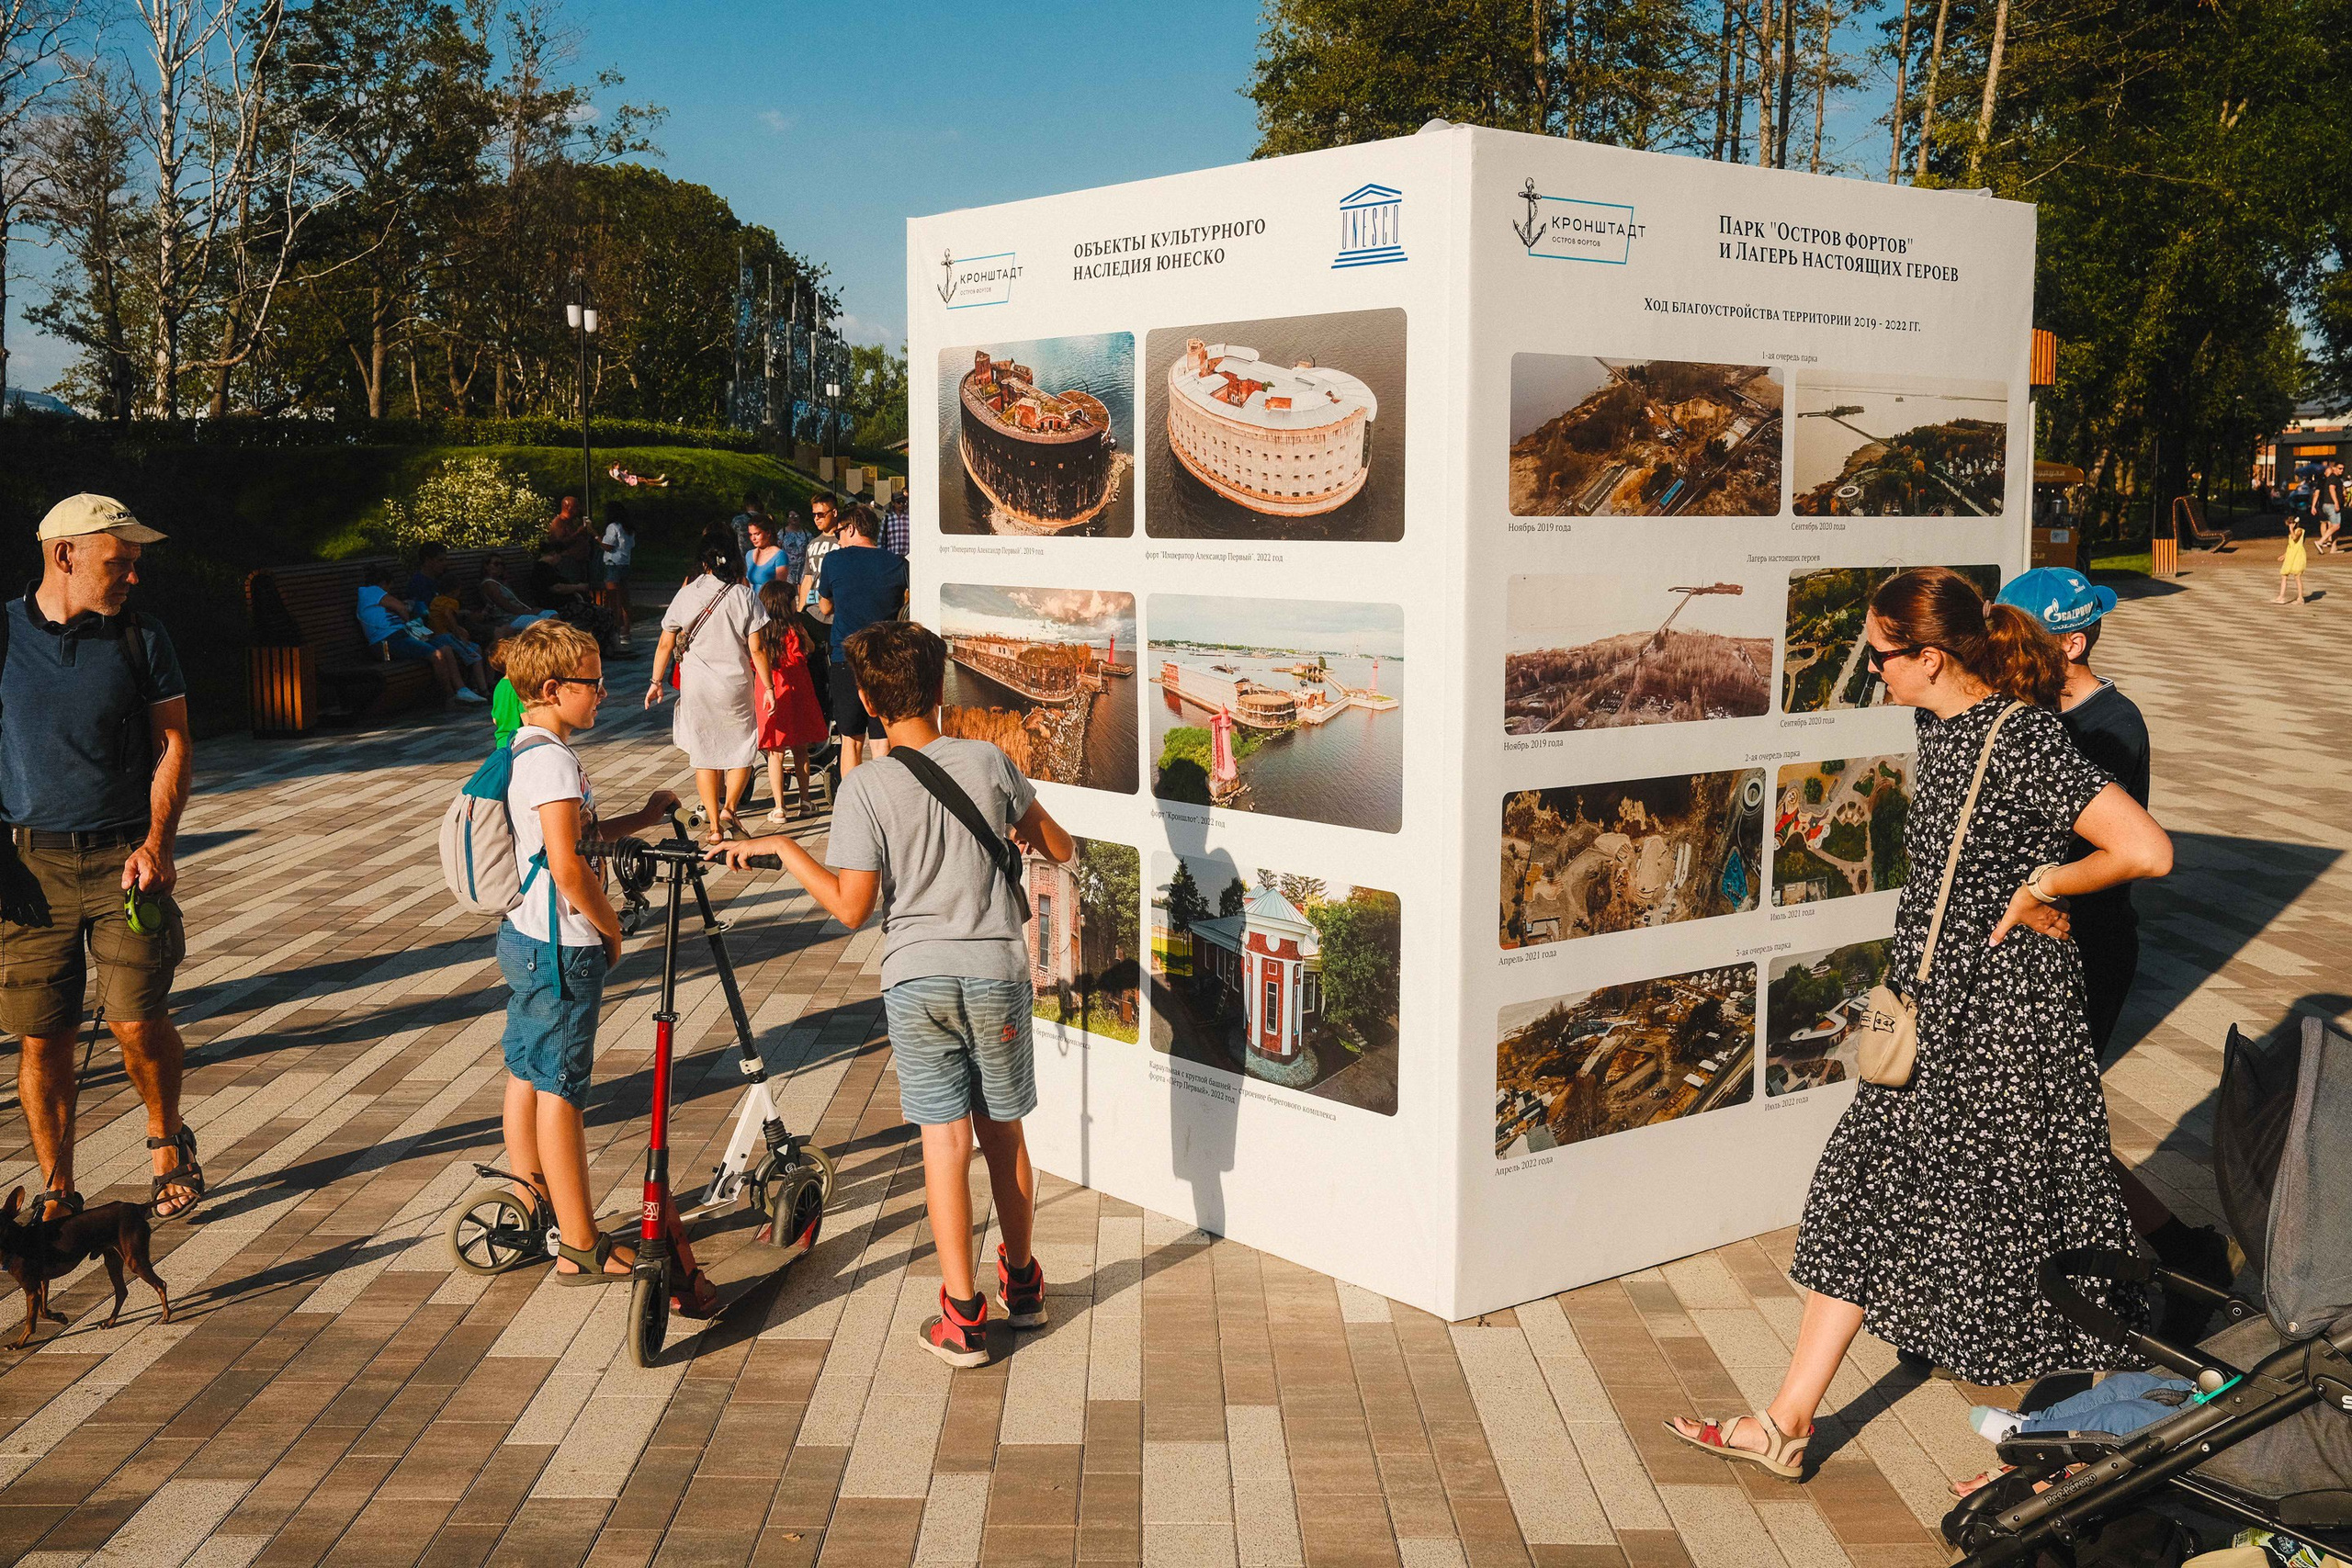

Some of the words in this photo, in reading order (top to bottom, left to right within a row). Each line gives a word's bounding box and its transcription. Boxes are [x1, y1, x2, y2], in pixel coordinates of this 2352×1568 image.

[1342, 204, 1399, 250] UNESCO
[1551, 216, 1646, 240] КРОНШТАДТ
[1074, 234, 1147, 259] ОБЪЕКТЫ
[1150, 218, 1266, 249] КУЛЬТУРНОГО
[1552, 236, 1577, 245] ОСТРОВ
[1577, 239, 1601, 247] ФОРТОВ
[1073, 256, 1152, 281] НАСЛЕДИЯ
[1156, 247, 1226, 271] ЮНЕСКО
[1802, 251, 1902, 277] НАСТОЯЩИХ
[1906, 263, 1960, 283] ГЕРОЕВ
[959, 266, 1023, 285] КРОНШТАДТ
[1672, 301, 1781, 321] БЛАГОУСТРОЙСТВА
[1782, 310, 1852, 327] ТЕРРИТОРИИ
[1854, 316, 1877, 331] 2019
[1885, 320, 1907, 332] 2022
[1761, 351, 1775, 361] 1-ая
[1775, 353, 1801, 363] очередь
[1801, 355, 1818, 364] парка
[1508, 523, 1536, 534] Ноябрь
[1537, 523, 1555, 532] 2019
[1555, 525, 1572, 533] года
[1791, 522, 1819, 533] Сентябрь
[1819, 522, 1833, 531] 2020
[1145, 550, 1159, 560] форт
[1195, 551, 1227, 562] Александр
[1256, 553, 1272, 562] 2022
[1272, 554, 1284, 563] год
[1747, 554, 1768, 564] Лагерь
[1768, 555, 1801, 563] настоящих
[1801, 555, 1821, 564] героев
[1780, 718, 1808, 728] Сентябрь
[1808, 716, 1822, 726] 2020
[1822, 716, 1836, 725] года
[1503, 740, 1530, 751] Ноябрь
[1531, 739, 1547, 750] 2019
[1547, 739, 1564, 748] года
[1758, 751, 1783, 761] очередь
[1782, 750, 1801, 760] парка
[1150, 809, 1165, 819] форт
[1200, 817, 1215, 827] 2022
[1215, 819, 1226, 829] год
[1770, 912, 1787, 921] Июль
[1787, 909, 1801, 919] 2021
[1802, 908, 1815, 917] года
[1749, 946, 1774, 955] очередь
[1773, 942, 1792, 952] парка
[1498, 955, 1524, 966] Апрель
[1524, 951, 1540, 962] 2021
[1542, 950, 1557, 959] года
[1148, 1071, 1166, 1083] форта
[1210, 1089, 1225, 1100] 2022
[1225, 1093, 1236, 1104] год
[1185, 1073, 1208, 1087] круглой
[1208, 1077, 1231, 1091] башней
[1238, 1087, 1267, 1101] строение
[1266, 1094, 1302, 1111] берегового
[1302, 1105, 1337, 1122] комплекса
[1781, 1098, 1795, 1108] 2022
[1795, 1096, 1809, 1105] года
[1495, 1165, 1521, 1177] Апрель
[1521, 1158, 1537, 1170] 2022
[1538, 1156, 1554, 1166] года
